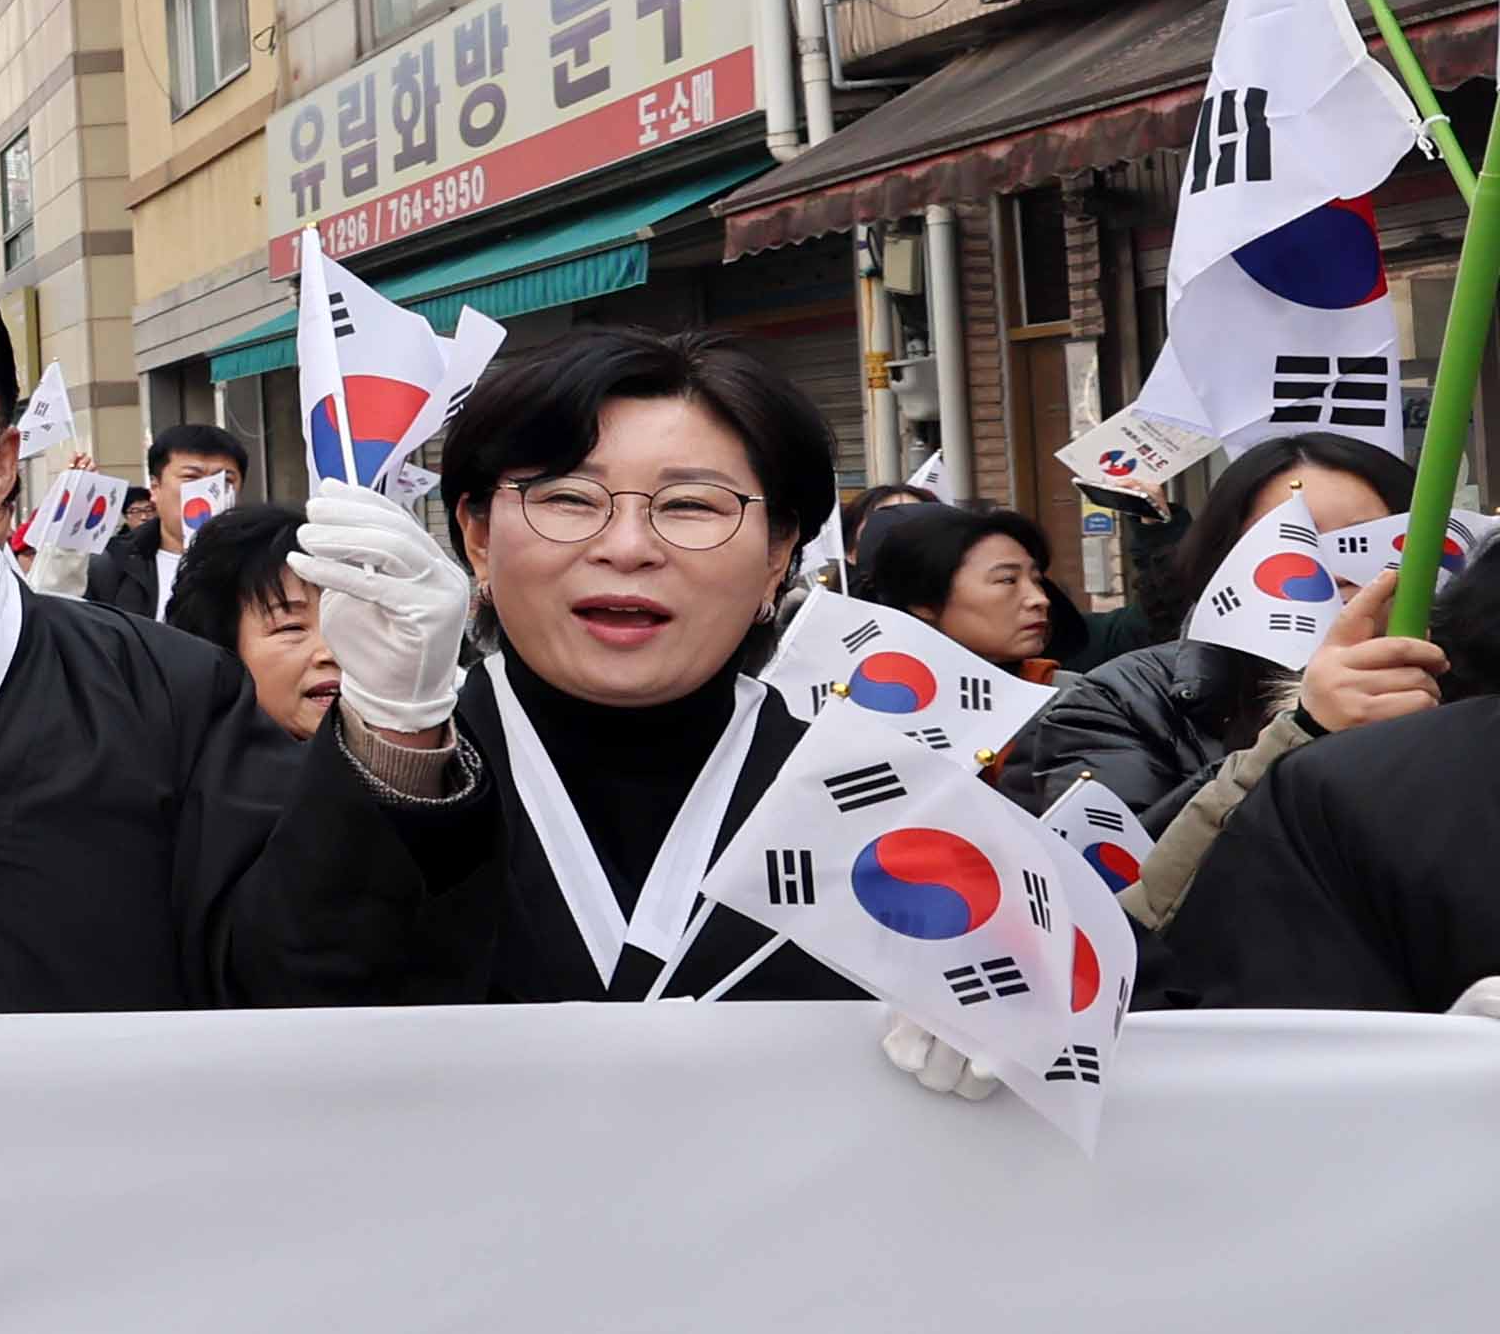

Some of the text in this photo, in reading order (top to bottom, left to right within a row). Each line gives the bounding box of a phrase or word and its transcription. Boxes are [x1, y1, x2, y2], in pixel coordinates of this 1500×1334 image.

[290, 2, 509, 218] 유림화방
[291, 210, 368, 269] 7-1296
[388, 164, 485, 235] 764-5950
